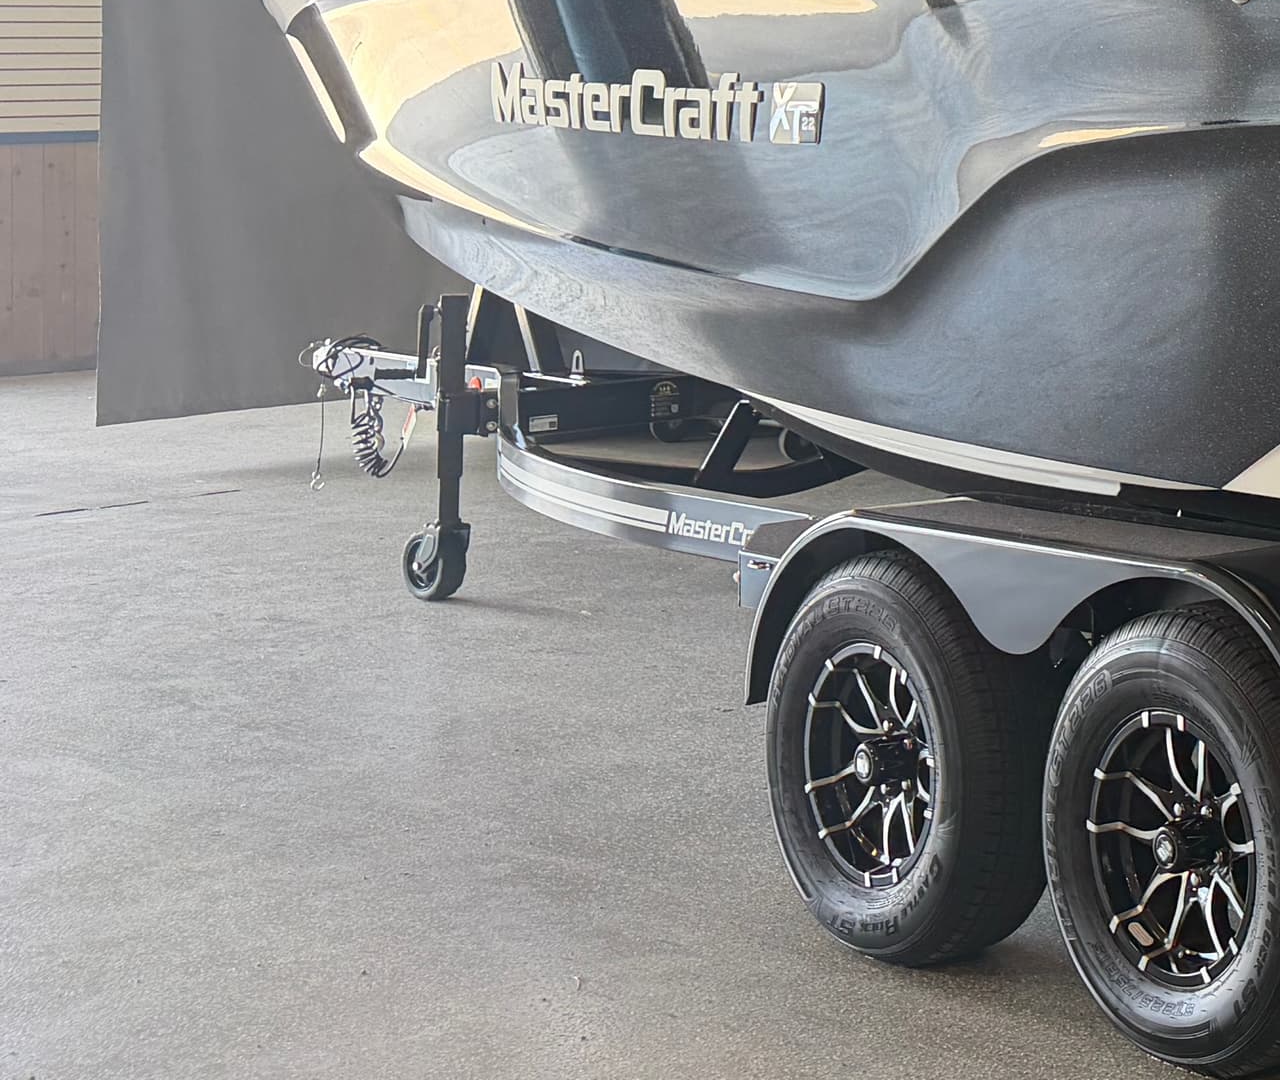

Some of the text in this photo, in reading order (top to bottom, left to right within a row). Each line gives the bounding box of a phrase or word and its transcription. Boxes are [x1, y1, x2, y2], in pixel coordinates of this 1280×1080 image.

[491, 61, 764, 143] MasterCraft
[801, 116, 816, 131] 22
[668, 511, 754, 546] MasterCr
